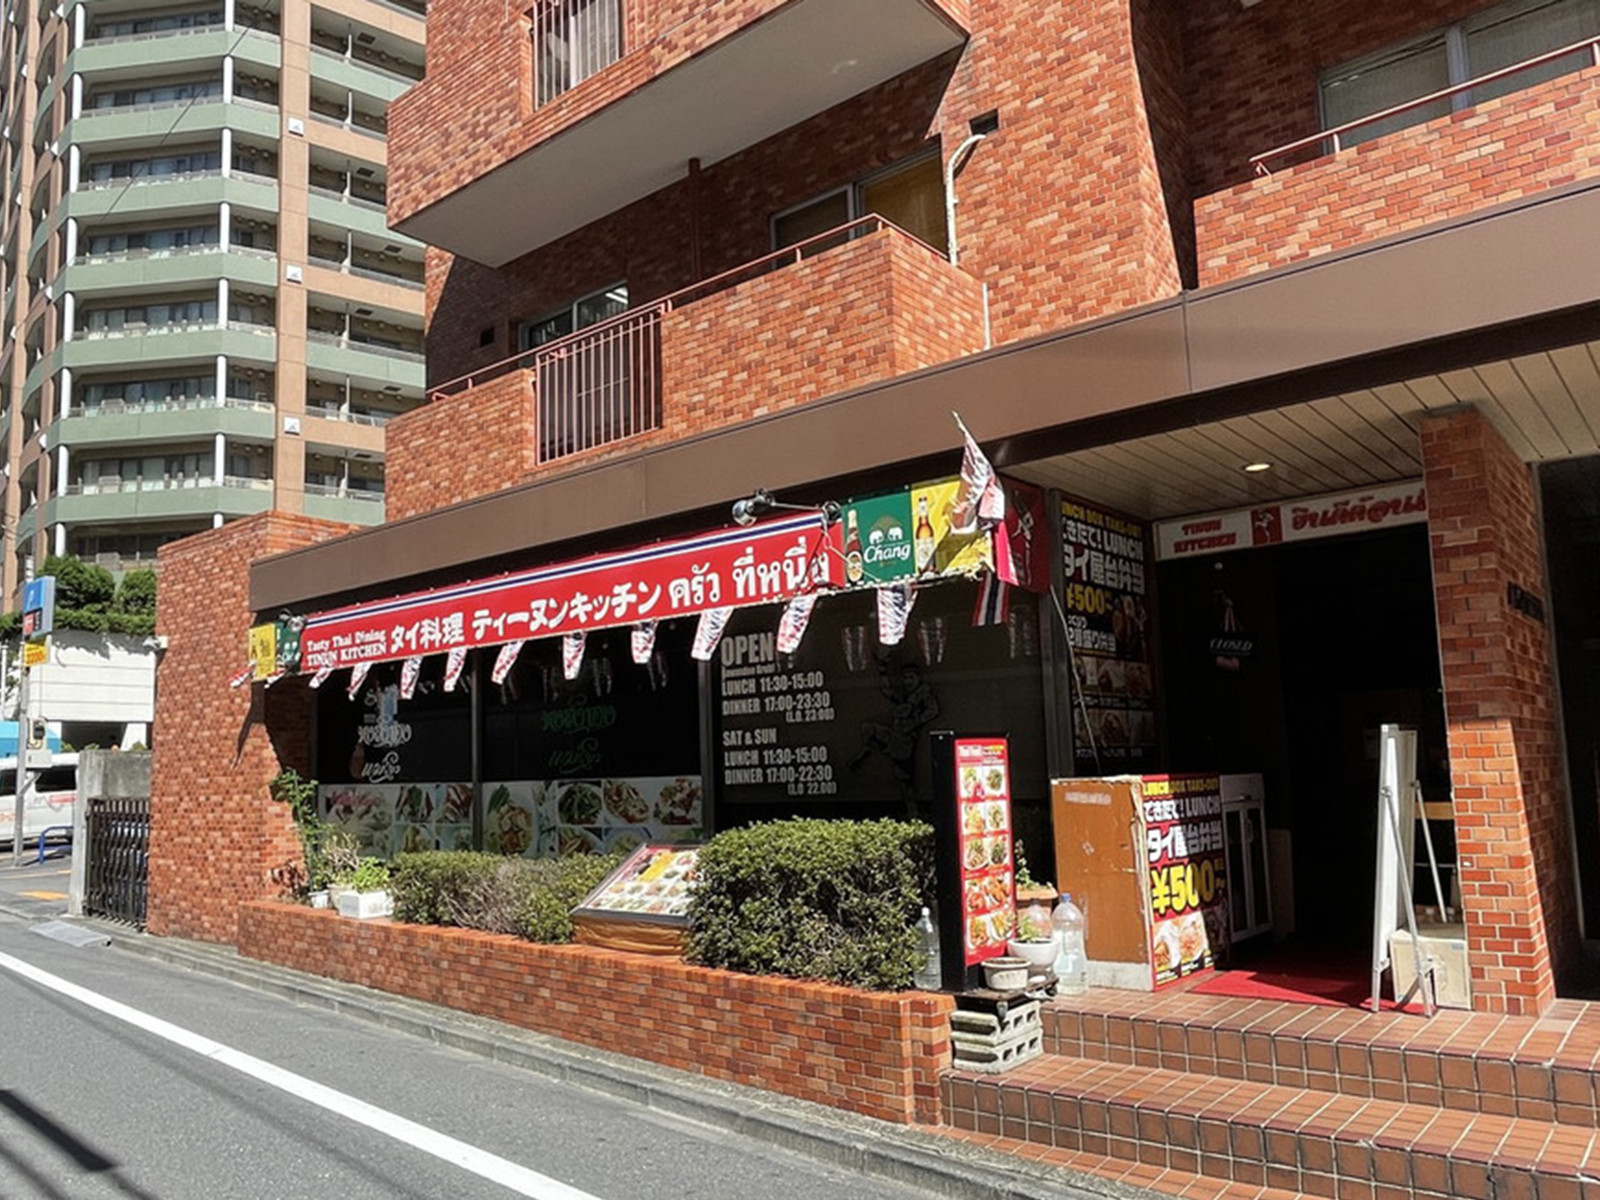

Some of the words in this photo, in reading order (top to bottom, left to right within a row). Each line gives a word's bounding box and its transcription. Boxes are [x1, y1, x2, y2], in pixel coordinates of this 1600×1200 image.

[863, 543, 911, 563] Chang
[391, 612, 464, 653] タイ料理
[472, 581, 662, 640] ティーヌンキッチン
[668, 562, 721, 608] ครัว
[332, 633, 353, 648] Thai
[355, 629, 387, 645] Dining
[340, 642, 387, 661] KITCHEN
[721, 632, 774, 667] OPEN
[722, 678, 756, 696] LUNCH
[760, 671, 824, 693] 11:30-15:00
[722, 698, 761, 715] DINNER
[764, 692, 830, 711] 17:00-23:30
[722, 730, 743, 746] SAT
[744, 732, 753, 745] &
[754, 728, 777, 743] SUN
[724, 750, 759, 766] LUNCH
[763, 746, 827, 765] 11:30-15:00
[724, 768, 763, 784] DINNER
[766, 765, 832, 784] 17:00-22:30
[1152, 859, 1215, 915] ¥500
